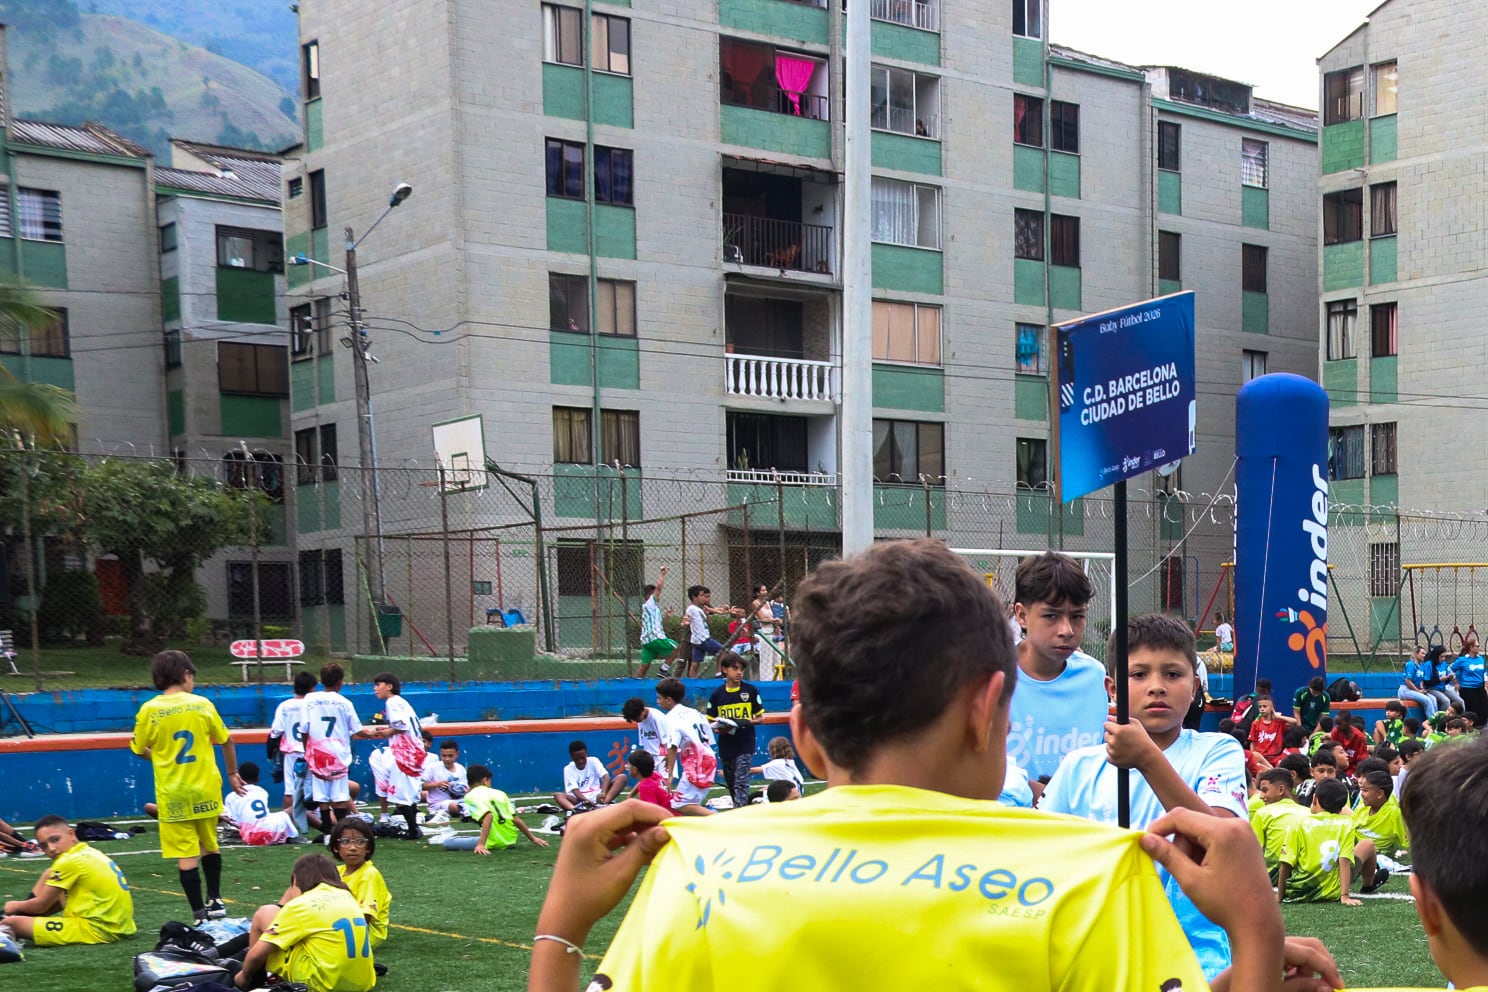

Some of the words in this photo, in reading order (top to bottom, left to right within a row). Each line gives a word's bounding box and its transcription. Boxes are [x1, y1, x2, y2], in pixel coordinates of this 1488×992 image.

[1100, 319, 1118, 333] Baby
[1083, 384, 1106, 405] C.D.
[1109, 361, 1178, 398] BARCELONA
[1081, 397, 1126, 426] CIUDAD
[1128, 391, 1143, 411] DE
[1146, 380, 1180, 405] BELLO
[1298, 464, 1328, 611] inder
[321, 716, 336, 737] 7
[1035, 727, 1100, 756] inder
[172, 729, 197, 765] 2
[193, 800, 219, 814] BELLO
[251, 800, 267, 818] 9
[1320, 840, 1339, 872] 8
[737, 845, 889, 884] Bello
[901, 854, 1054, 906] Aseo
[332, 917, 370, 958] 17
